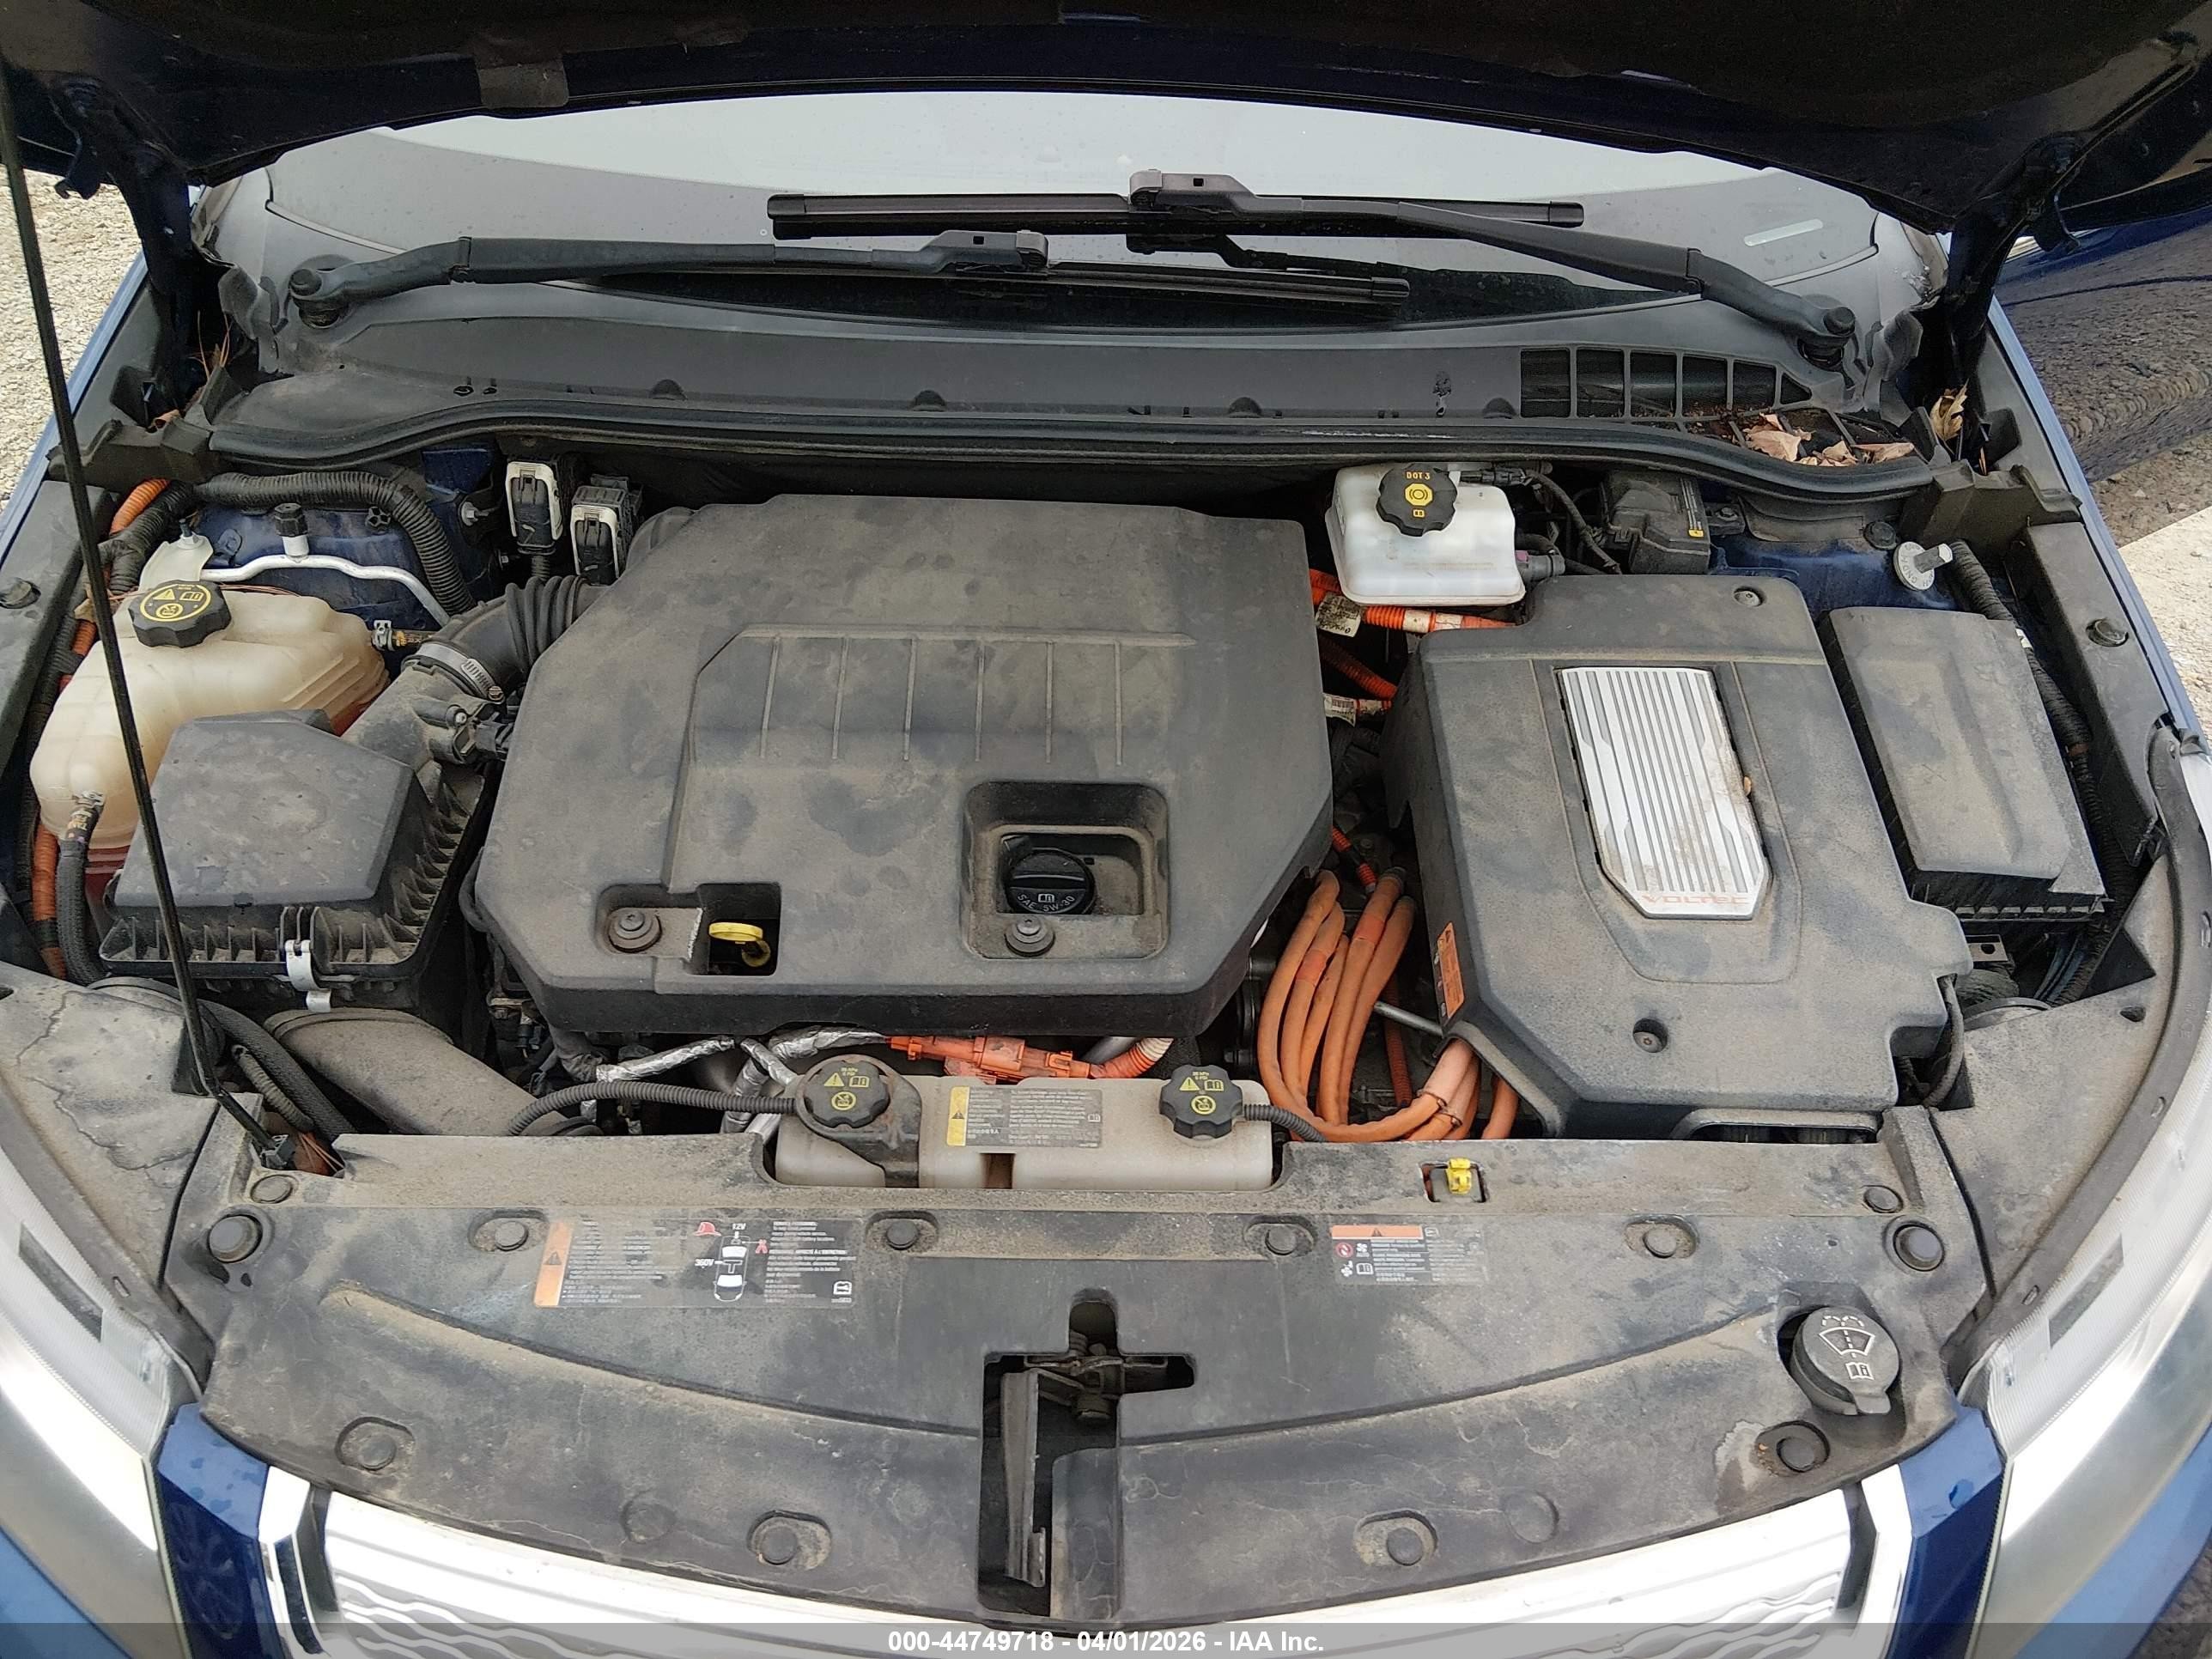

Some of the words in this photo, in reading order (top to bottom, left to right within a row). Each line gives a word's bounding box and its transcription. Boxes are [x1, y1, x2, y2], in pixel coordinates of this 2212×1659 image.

[1018, 894, 1037, 909] SAE
[1042, 896, 1075, 912] 5W-30
[1642, 895, 1749, 904] VOLTEC
